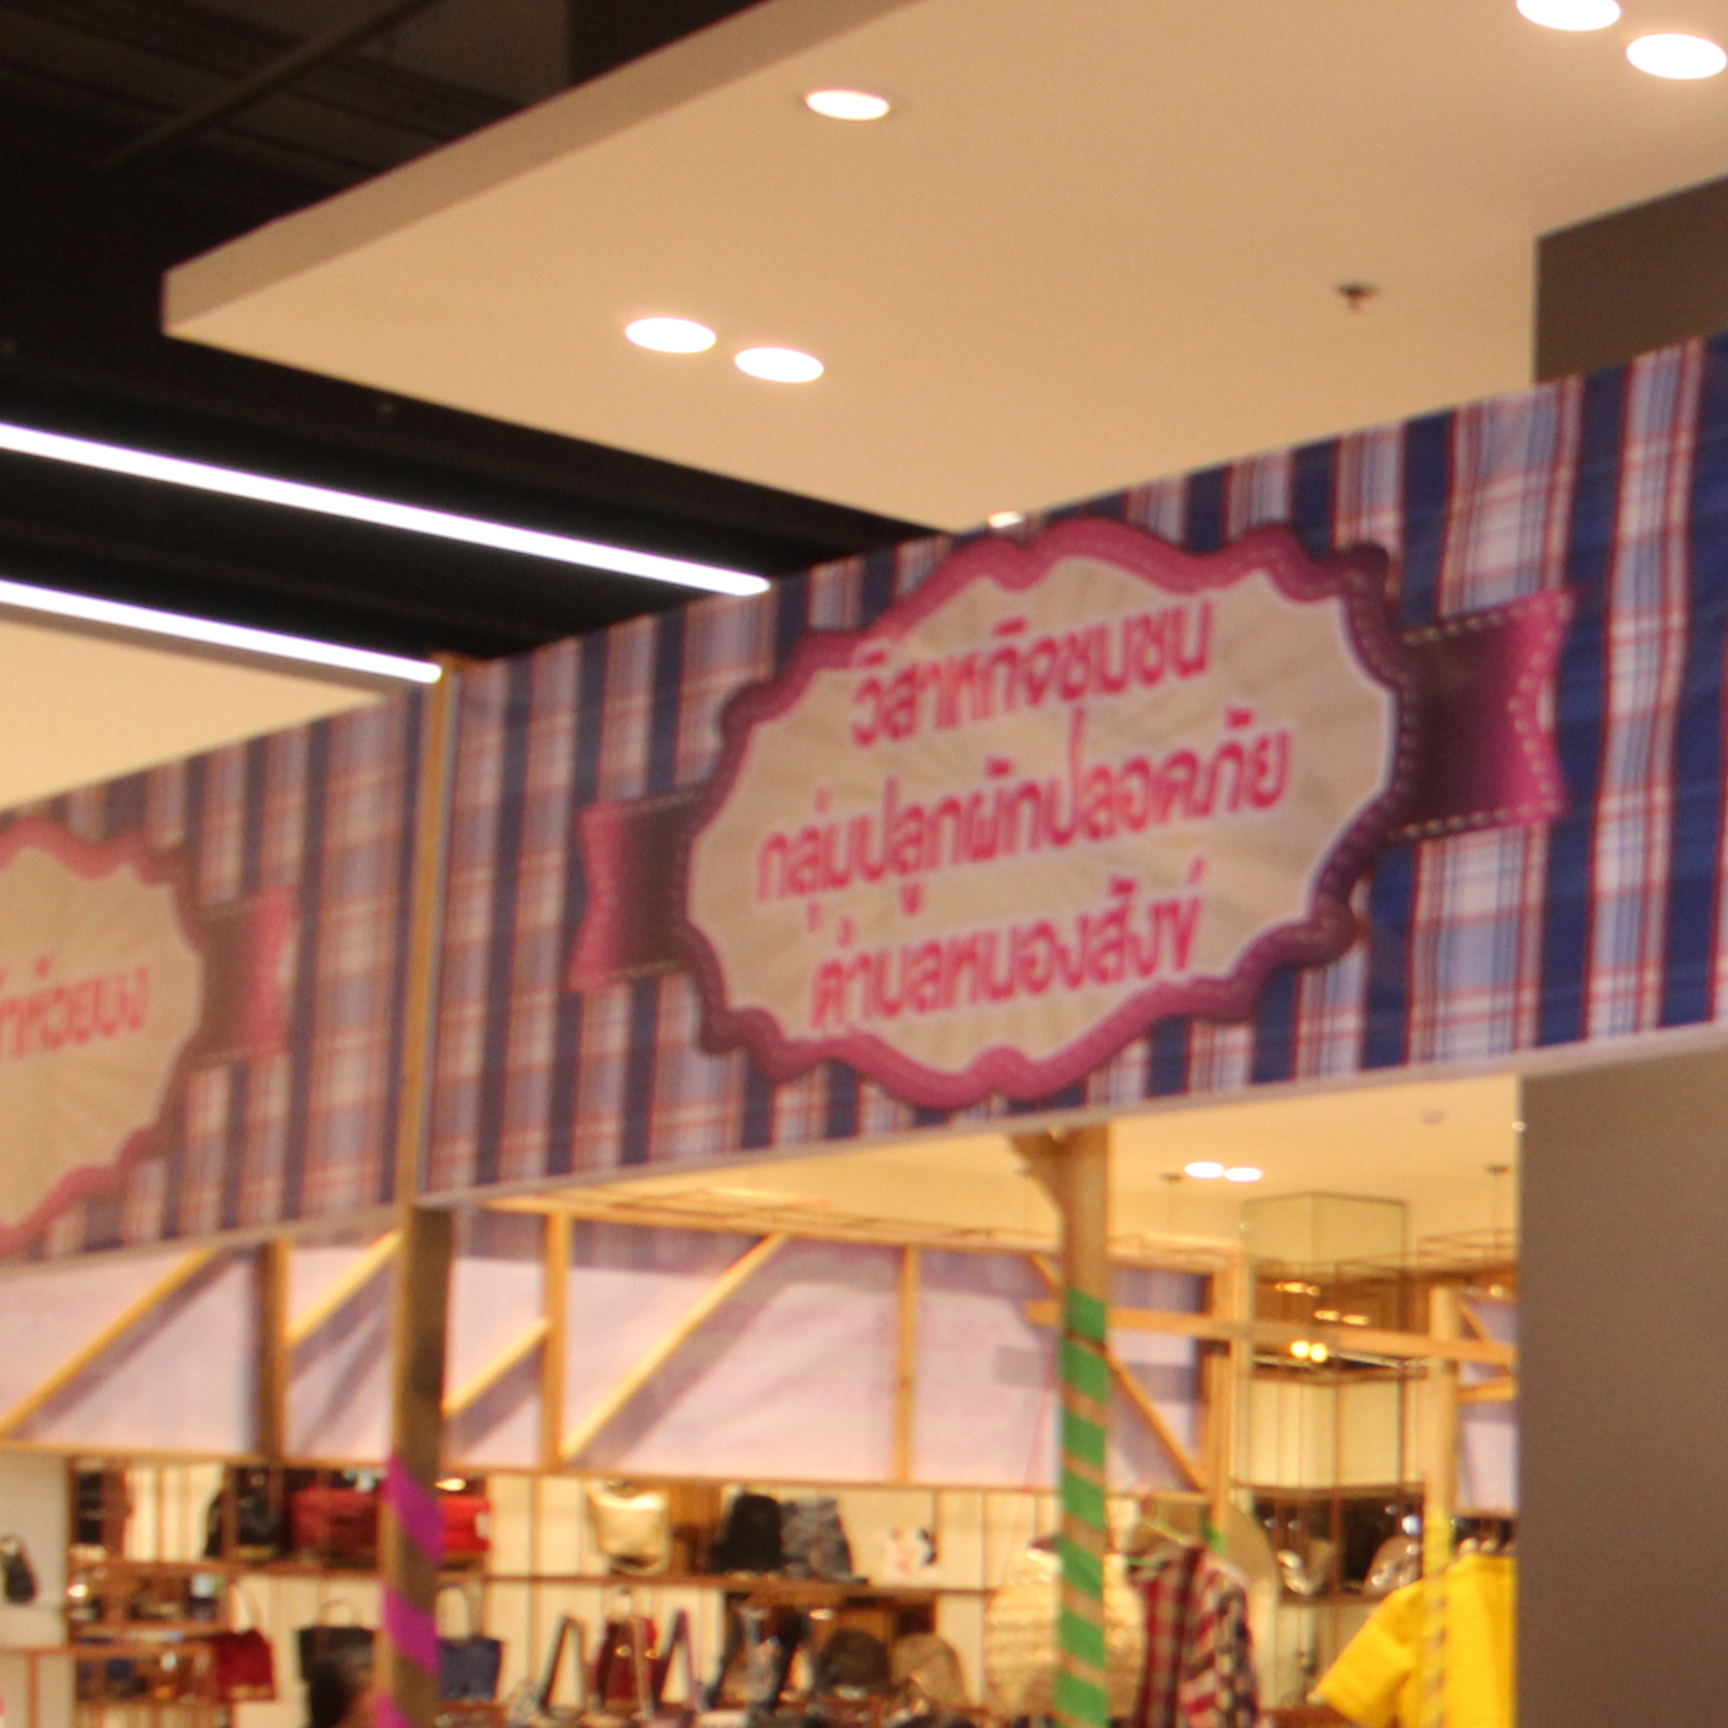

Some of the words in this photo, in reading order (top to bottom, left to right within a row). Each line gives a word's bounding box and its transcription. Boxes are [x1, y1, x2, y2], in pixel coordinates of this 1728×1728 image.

[852, 602, 1213, 746] วิสาหกิจชุมชน
